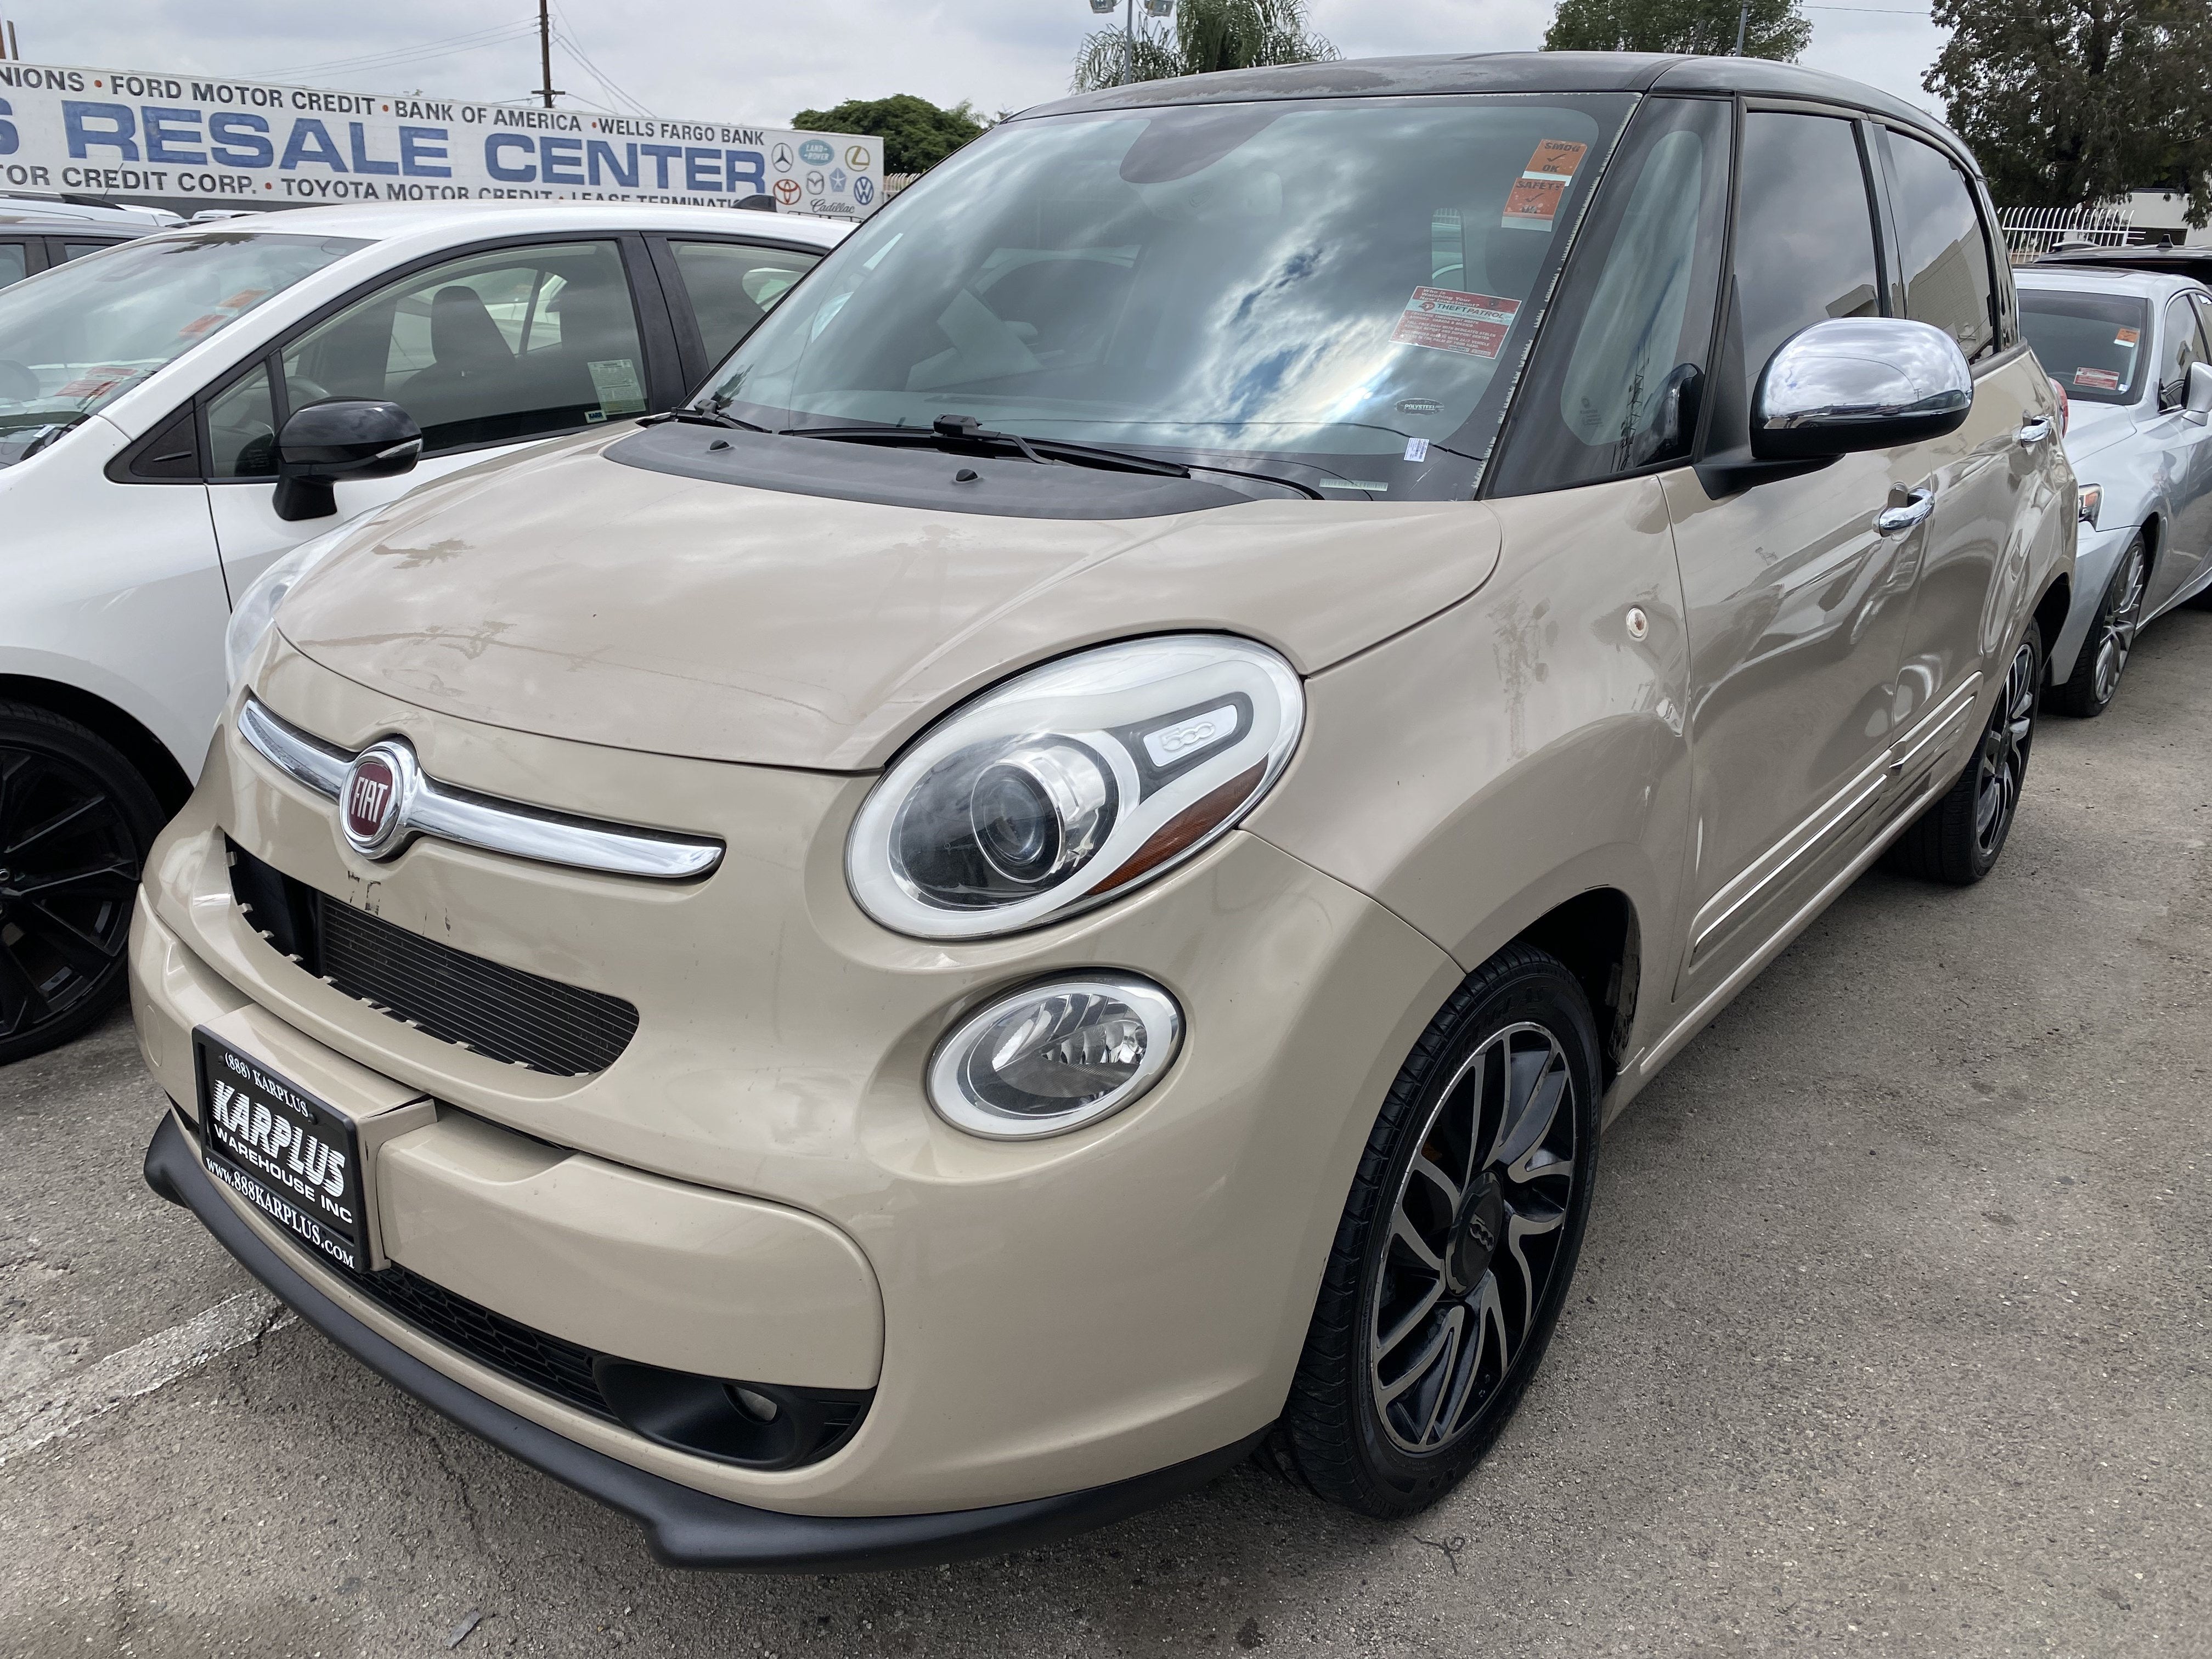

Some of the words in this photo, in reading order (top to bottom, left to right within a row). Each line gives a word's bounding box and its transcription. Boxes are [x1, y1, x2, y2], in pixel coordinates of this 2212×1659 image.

[110, 75, 182, 99] FORD
[191, 82, 283, 108] MOTOR
[291, 91, 375, 115] CREDIT
[394, 100, 454, 121] BANK
[461, 106, 487, 124] OF
[493, 109, 582, 132] AMERICA
[599, 118, 654, 137] WELLS
[661, 123, 715, 142] FARGO
[721, 128, 765, 145] BANK
[61, 100, 452, 178] RESALE
[484, 133, 765, 194] CENTER
[0, 165, 50, 185] OR
[62, 167, 167, 190] CREDIT
[177, 172, 257, 194] CORP.
[281, 178, 380, 199] TOYOTA
[386, 183, 470, 201] MOTOR
[810, 199, 855, 213] Cadillac
[1421, 292, 1453, 301] Watching
[1161, 722, 1216, 752] 500
[351, 776, 388, 823] FIAT
[225, 1052, 251, 1080] (888)
[252, 1069, 309, 1118] KARPLUS
[212, 1079, 346, 1197] KARPLUS
[214, 1124, 315, 1203] WAREHOUSE
[321, 1194, 353, 1224] INC
